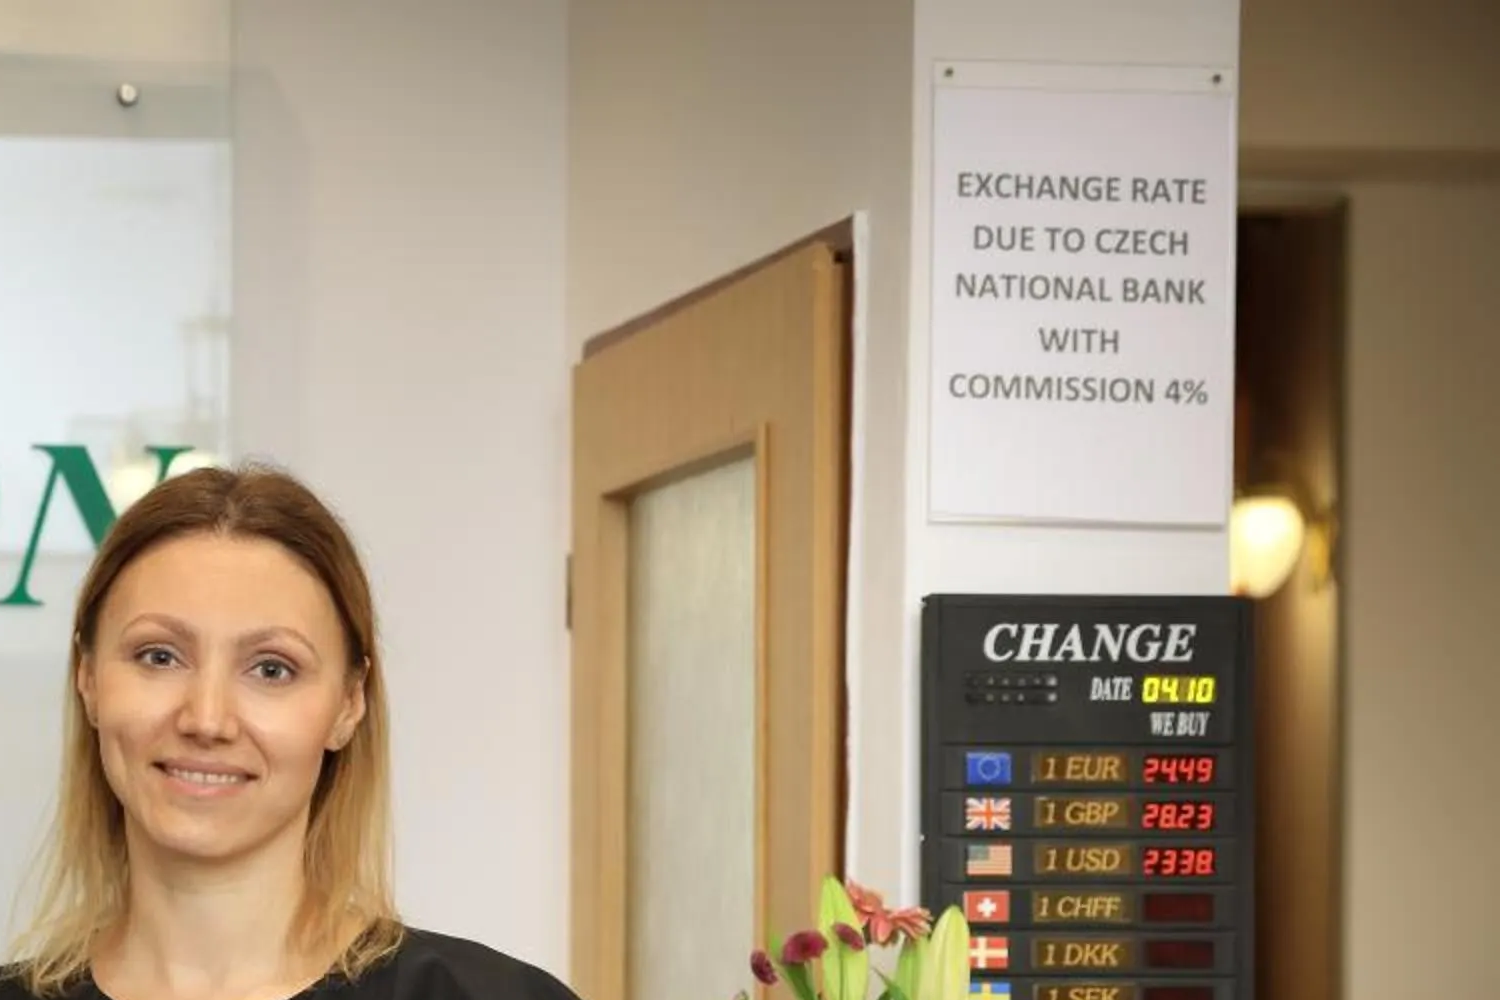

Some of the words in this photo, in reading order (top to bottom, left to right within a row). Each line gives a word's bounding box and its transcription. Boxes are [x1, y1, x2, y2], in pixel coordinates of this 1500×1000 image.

[957, 172, 1120, 203] EXCHANGE
[1131, 178, 1207, 205] RATE
[973, 225, 1035, 252] DUE
[1045, 227, 1086, 254] TO
[1094, 228, 1190, 257] CZECH
[955, 273, 1112, 303] NATIONAL
[1122, 277, 1206, 305] BANK
[1039, 328, 1120, 354] WITH
[949, 373, 1156, 404] COMMISSION
[1164, 379, 1210, 406] 4%
[982, 623, 1198, 663] CHANGE
[1090, 676, 1133, 701] DATE
[1150, 711, 1175, 736] WE
[1176, 711, 1211, 737] BUY
[1044, 756, 1057, 781] 1
[1064, 756, 1121, 781] EUR
[1044, 802, 1056, 825] 1
[1064, 801, 1119, 826] GBP
[1046, 848, 1059, 872] 1
[1066, 848, 1121, 872] USD
[1038, 897, 1049, 918] 1
[1056, 896, 1122, 919] CHFF
[1043, 945, 1056, 967] 1
[1063, 944, 1120, 968] DKK
